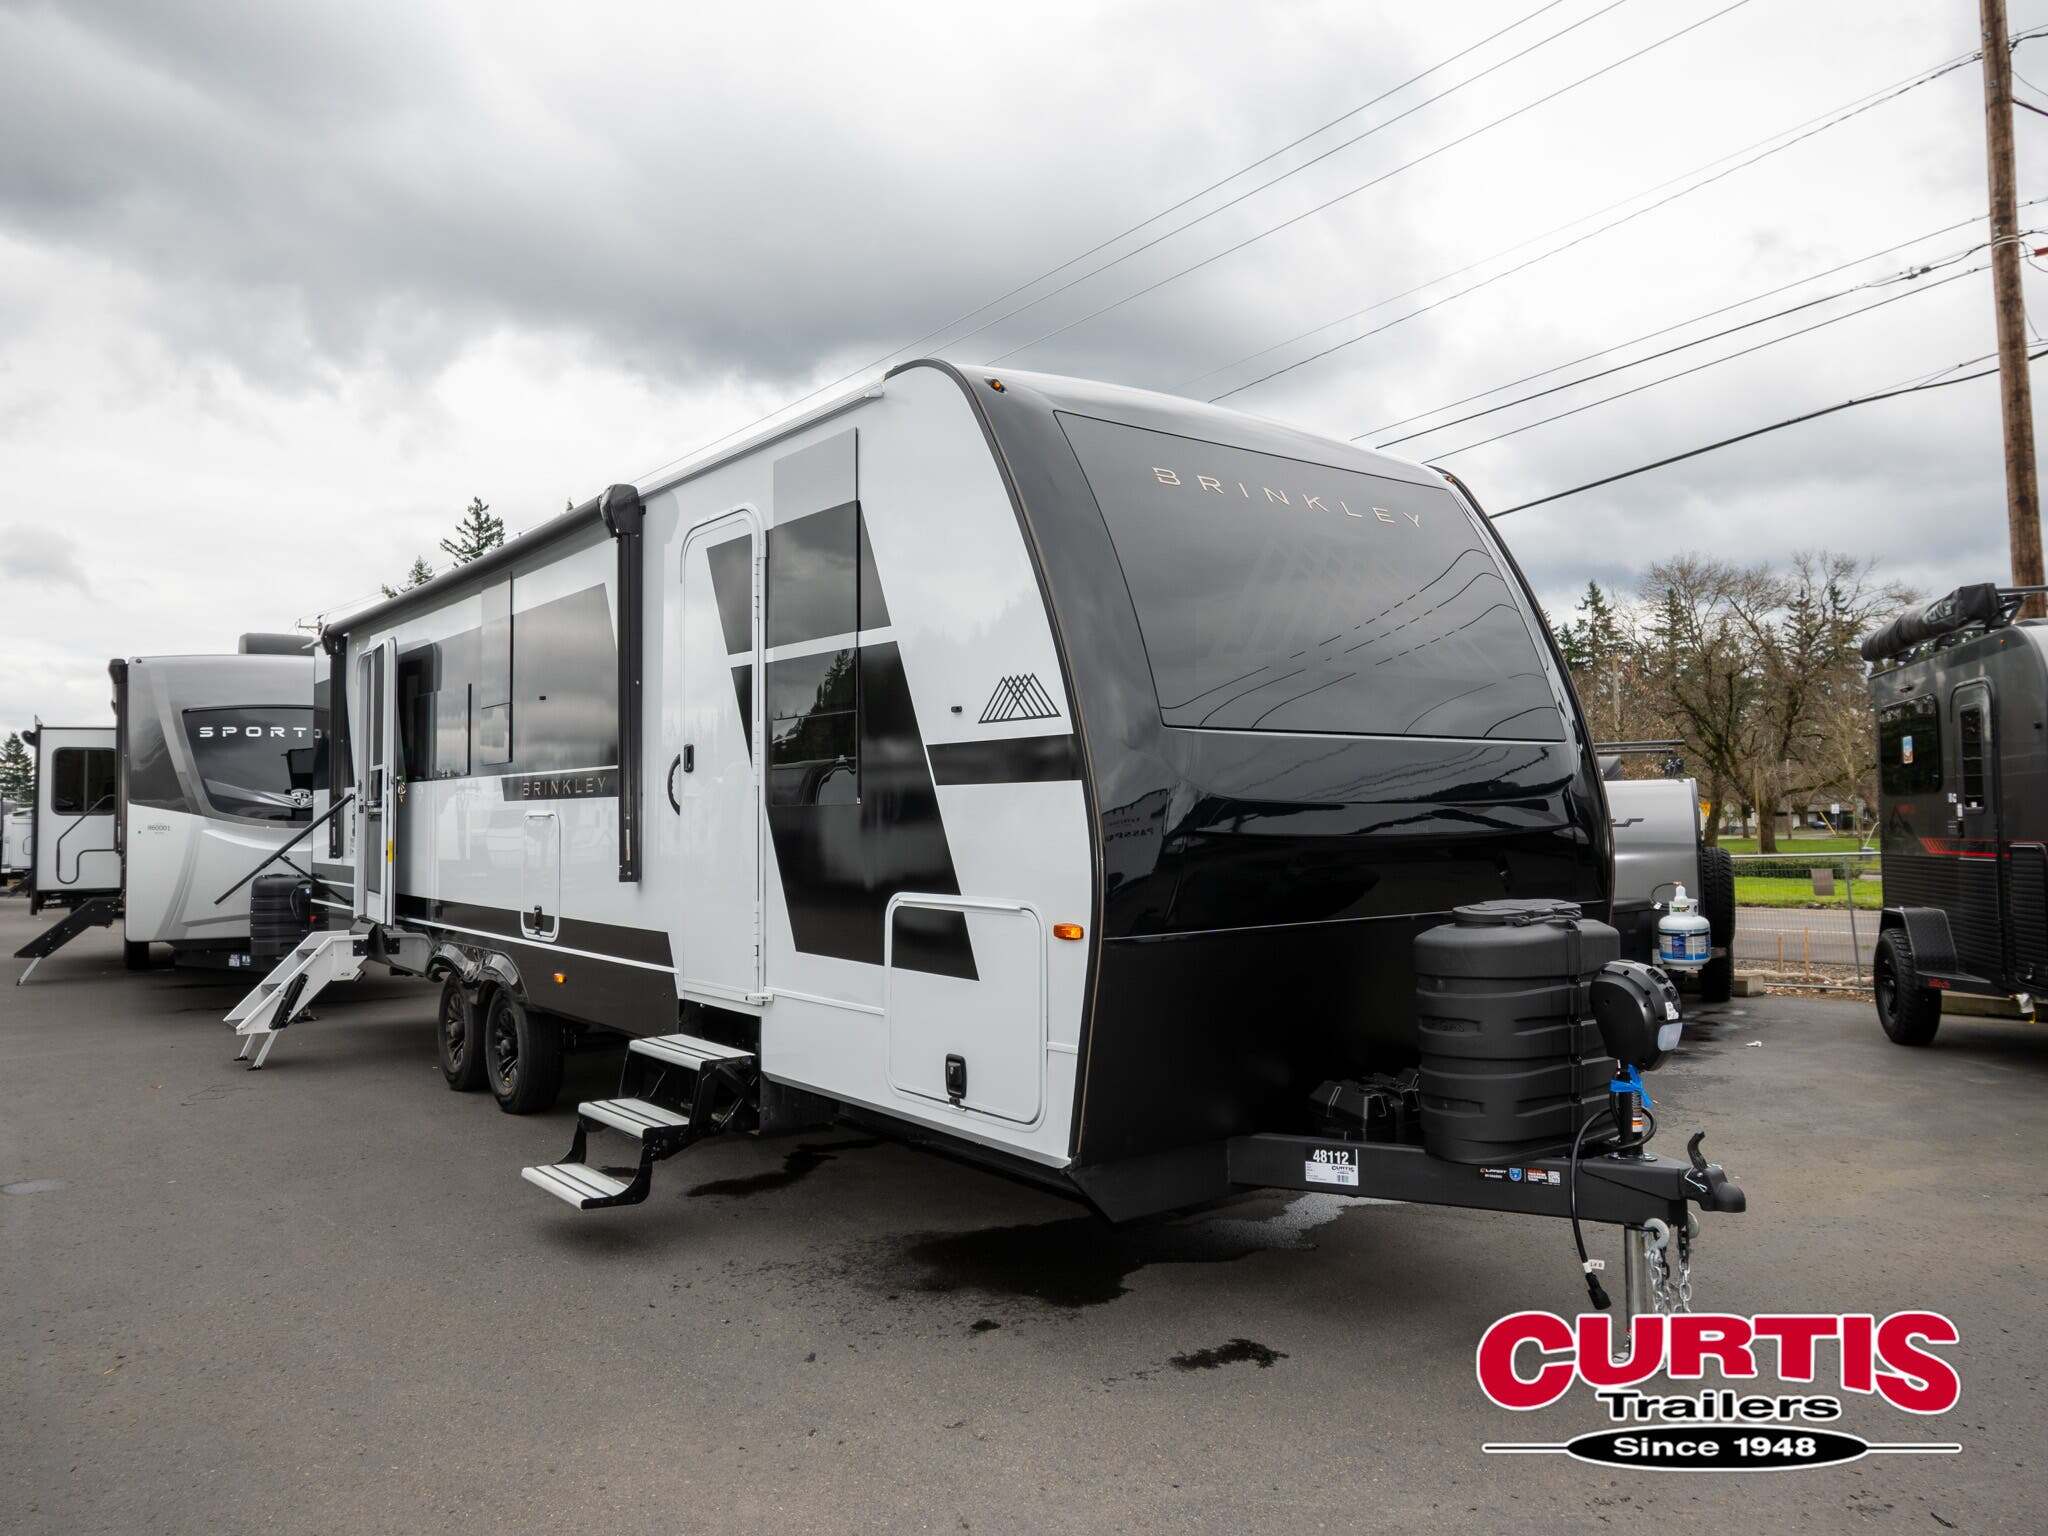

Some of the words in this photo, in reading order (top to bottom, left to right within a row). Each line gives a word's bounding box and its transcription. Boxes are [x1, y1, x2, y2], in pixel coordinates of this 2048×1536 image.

[1152, 466, 1420, 529] BRINKLEY
[522, 777, 606, 796] BRINKLEY
[1312, 1149, 1350, 1165] 48112
